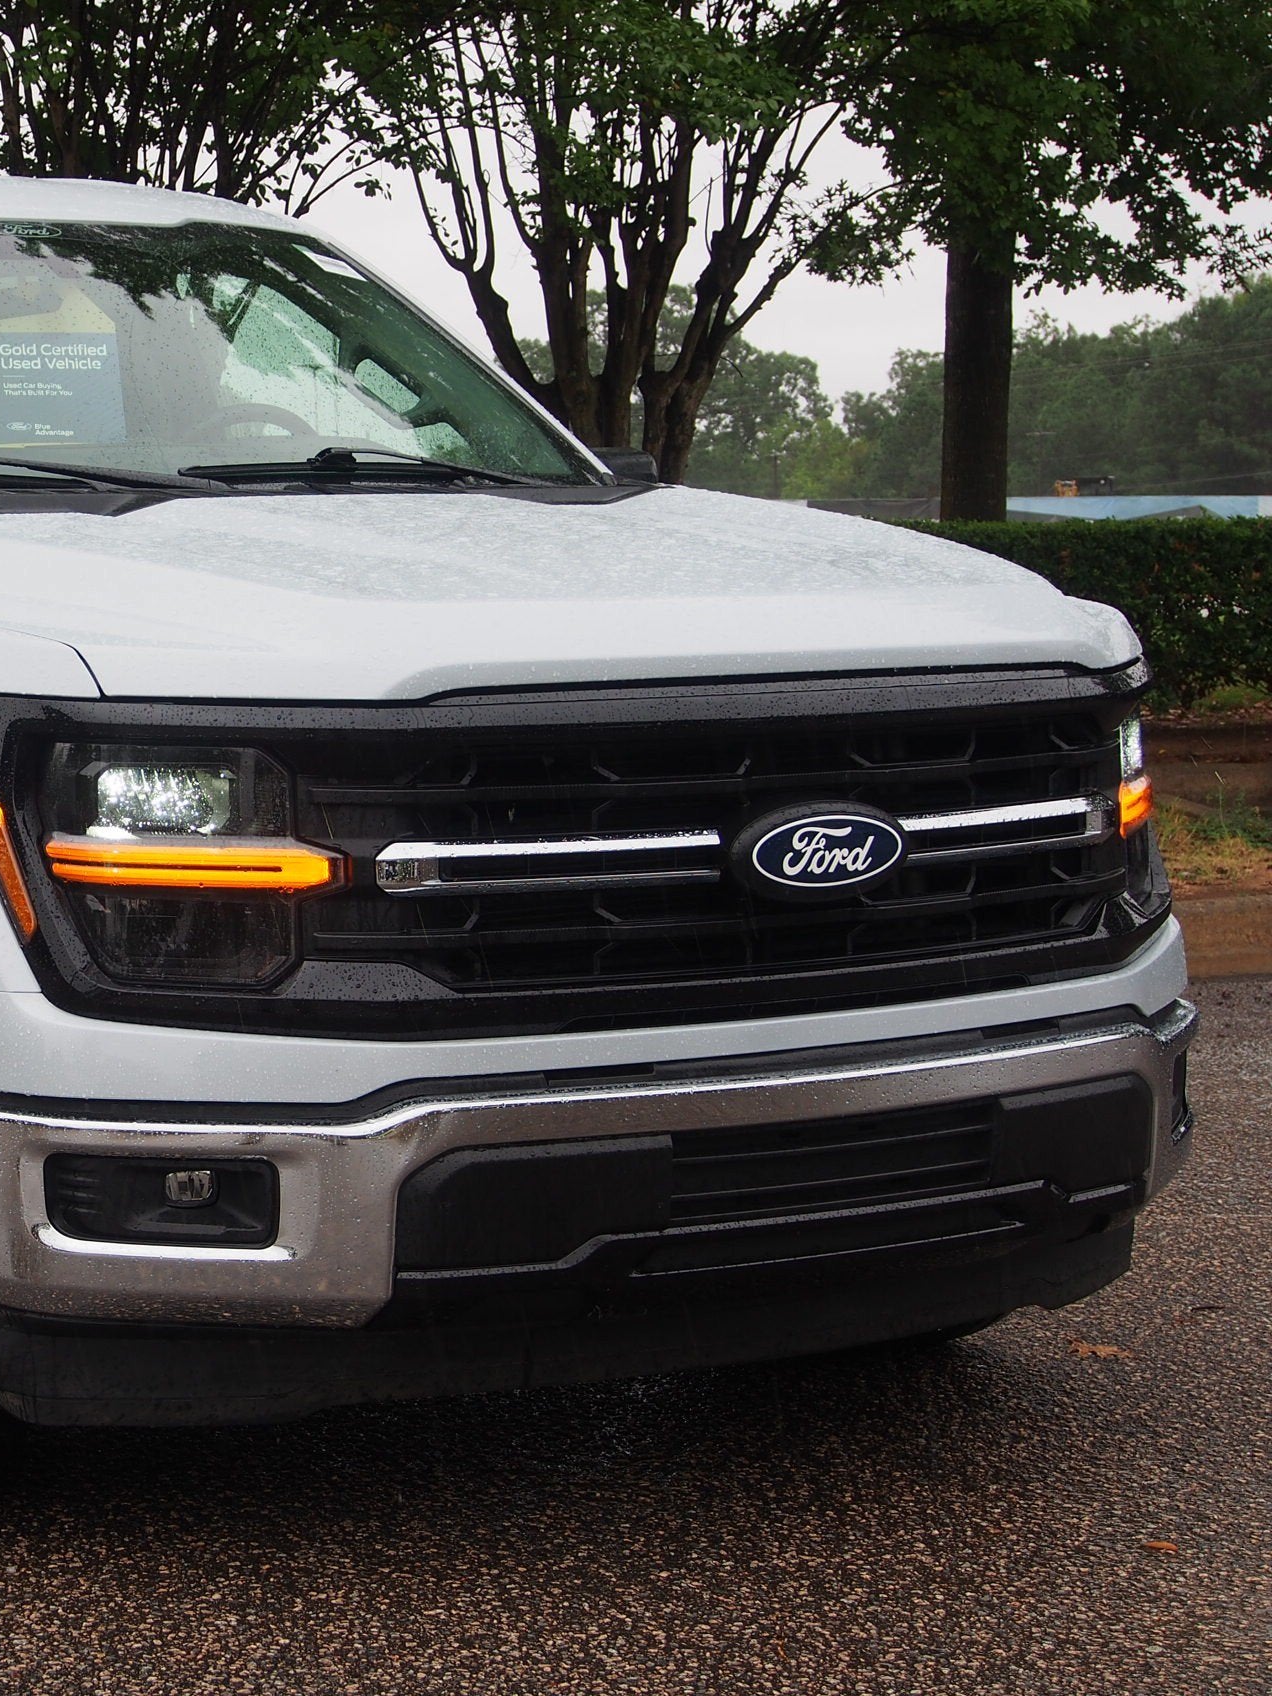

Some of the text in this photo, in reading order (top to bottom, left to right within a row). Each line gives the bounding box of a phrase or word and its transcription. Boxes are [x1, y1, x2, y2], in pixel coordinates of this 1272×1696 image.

[3, 223, 50, 236] Ford
[0, 343, 108, 356] Gold Certified
[0, 357, 102, 370] Used Vehicle
[782, 826, 875, 876] Ford
